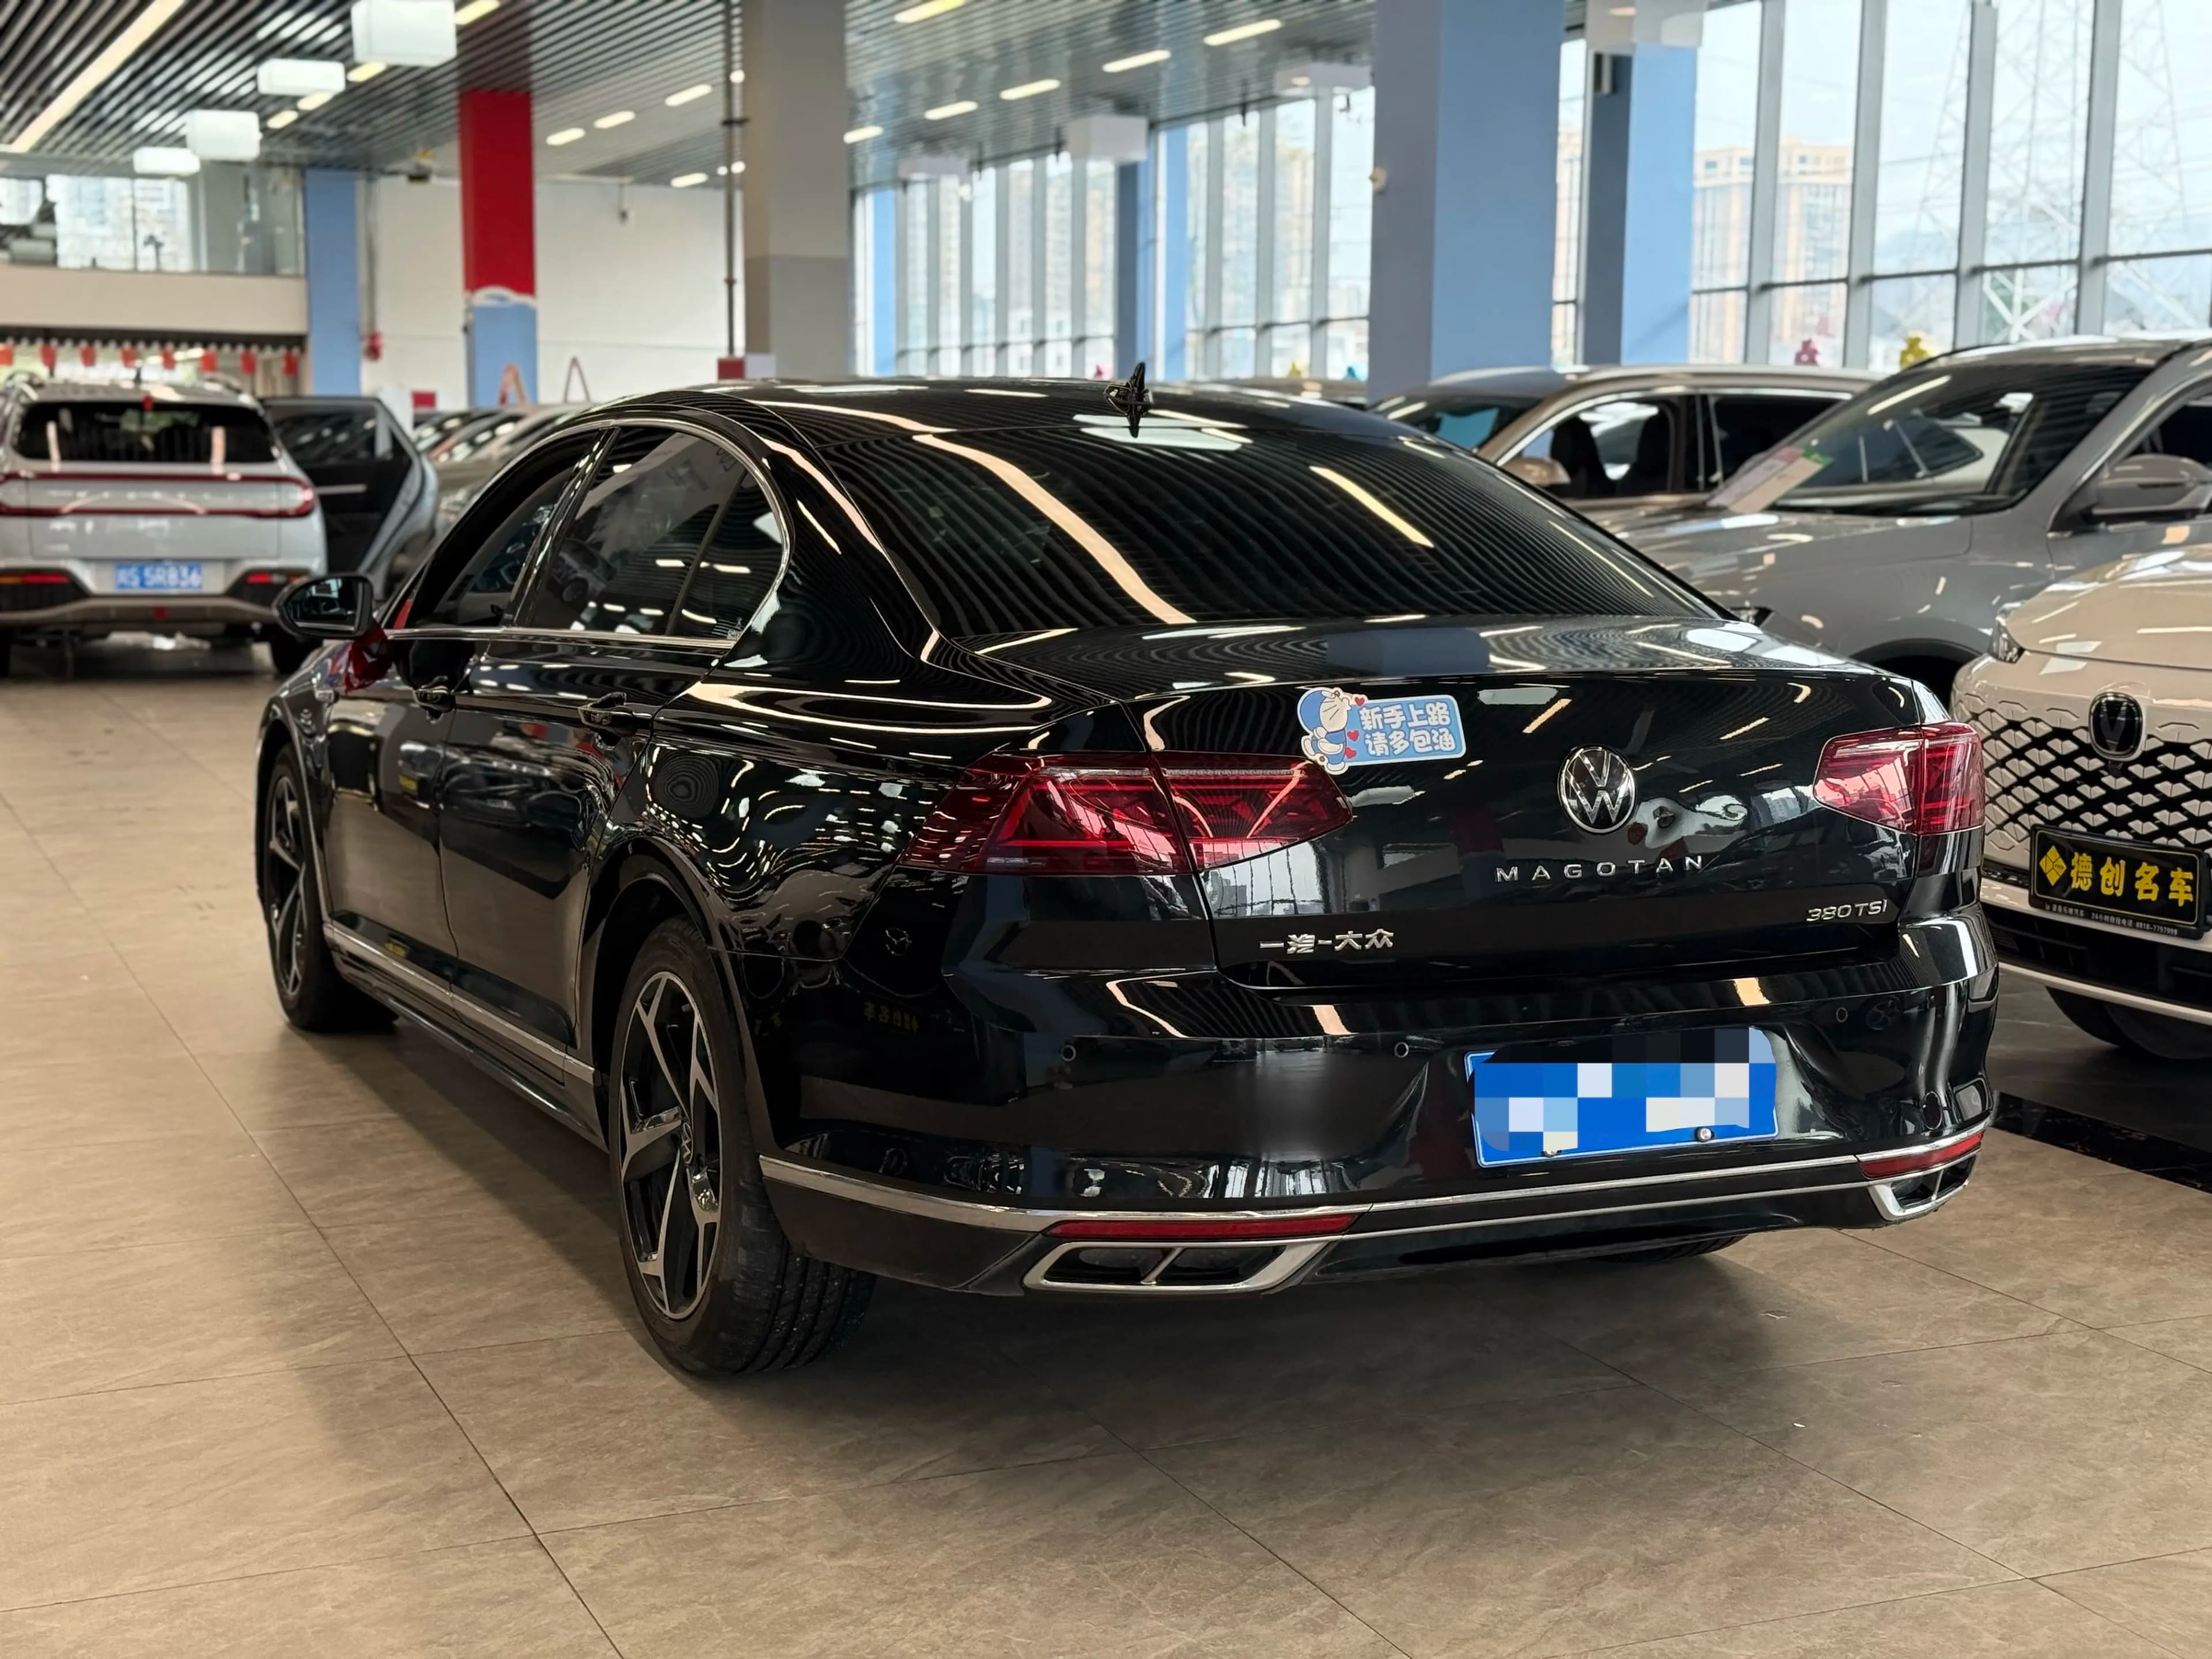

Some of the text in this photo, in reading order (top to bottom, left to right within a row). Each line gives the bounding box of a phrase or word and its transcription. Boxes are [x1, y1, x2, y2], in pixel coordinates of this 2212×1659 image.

[1359, 701, 1451, 730] 新手上路
[1365, 728, 1456, 756] 请多包涵
[1495, 855, 1703, 882] MAGOTAN
[2070, 851, 2194, 907] 德创名车
